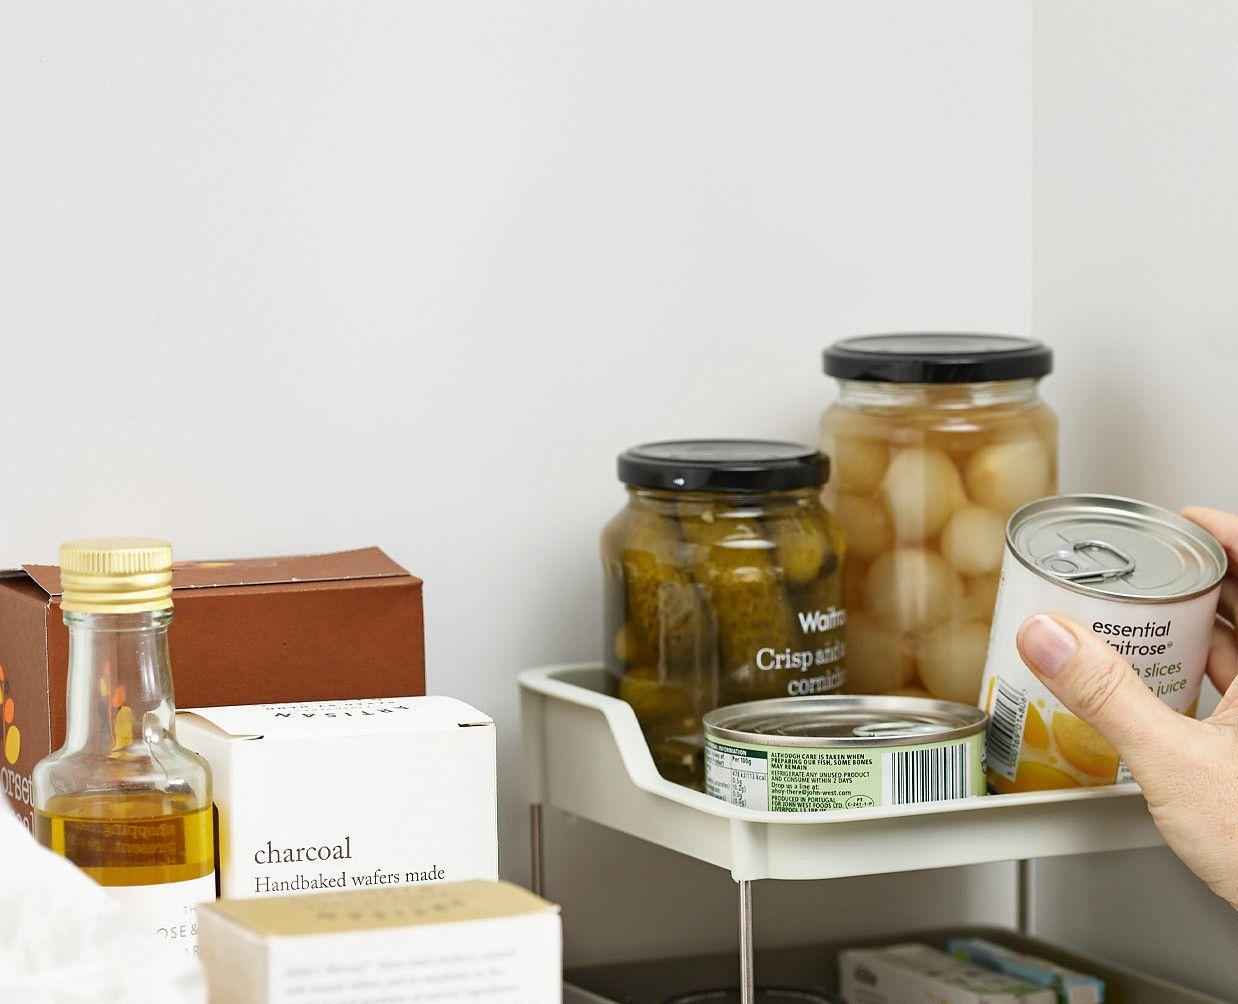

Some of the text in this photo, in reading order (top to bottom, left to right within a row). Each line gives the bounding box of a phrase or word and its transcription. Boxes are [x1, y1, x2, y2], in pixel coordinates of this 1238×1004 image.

[1092, 620, 1171, 638] essential
[1106, 640, 1166, 656] itrose
[756, 647, 813, 672] Crisp
[1144, 661, 1182, 678] slices
[1156, 679, 1187, 697] juice
[254, 836, 352, 864] charcoal
[254, 865, 446, 893] Handbaked wafers made
